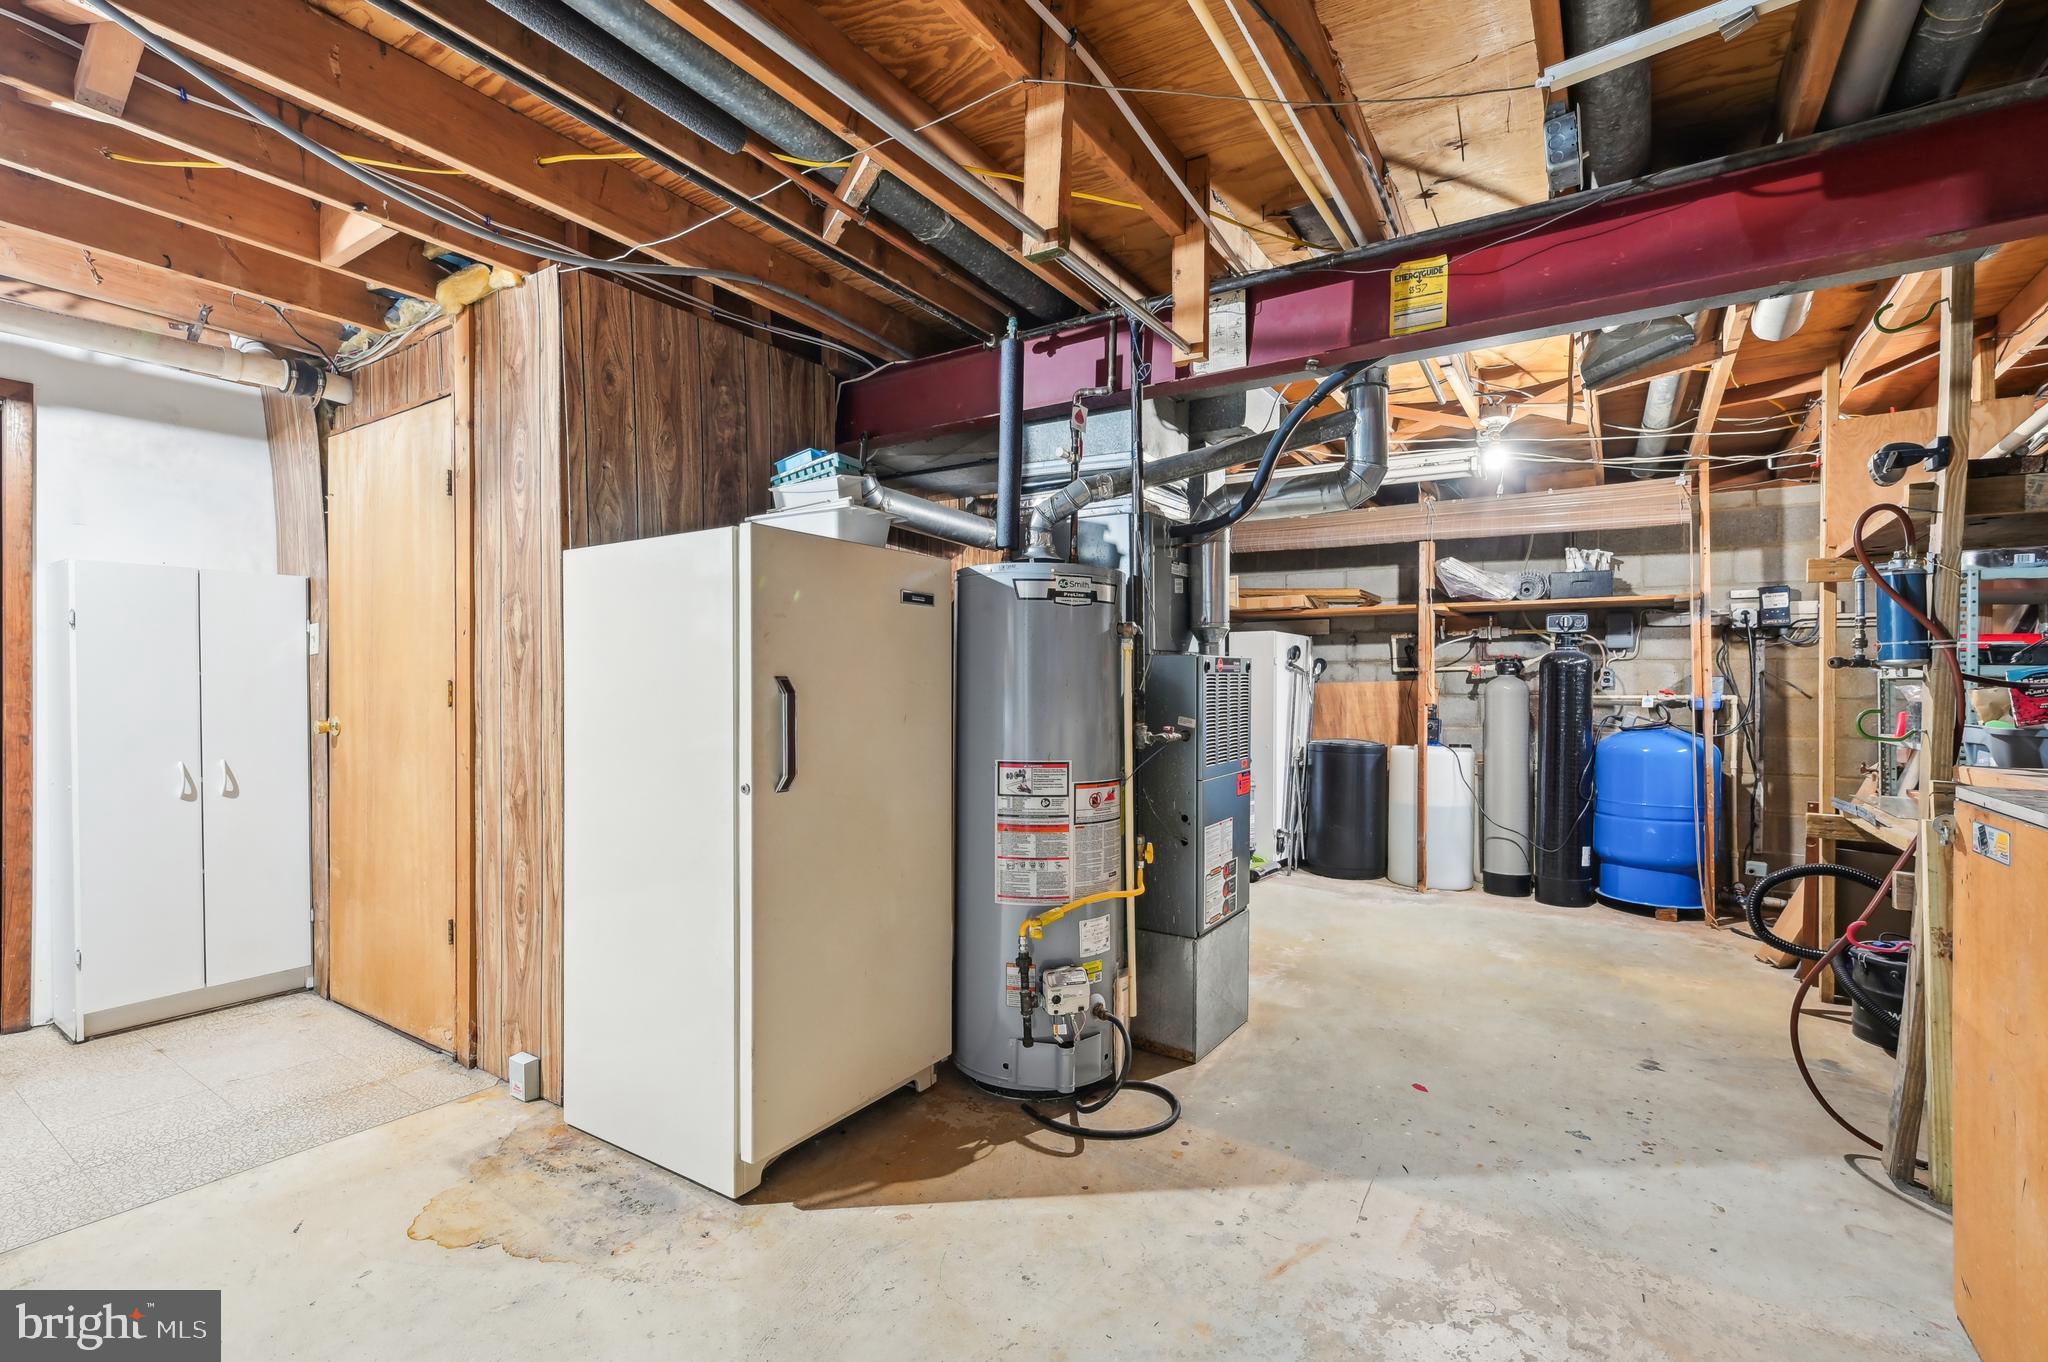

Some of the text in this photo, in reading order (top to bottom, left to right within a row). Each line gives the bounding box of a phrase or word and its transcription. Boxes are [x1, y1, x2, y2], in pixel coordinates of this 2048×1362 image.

[1394, 266, 1444, 283] ENERGYGUIDE
[1408, 283, 1428, 294] $57
[1070, 581, 1090, 589] Smith
